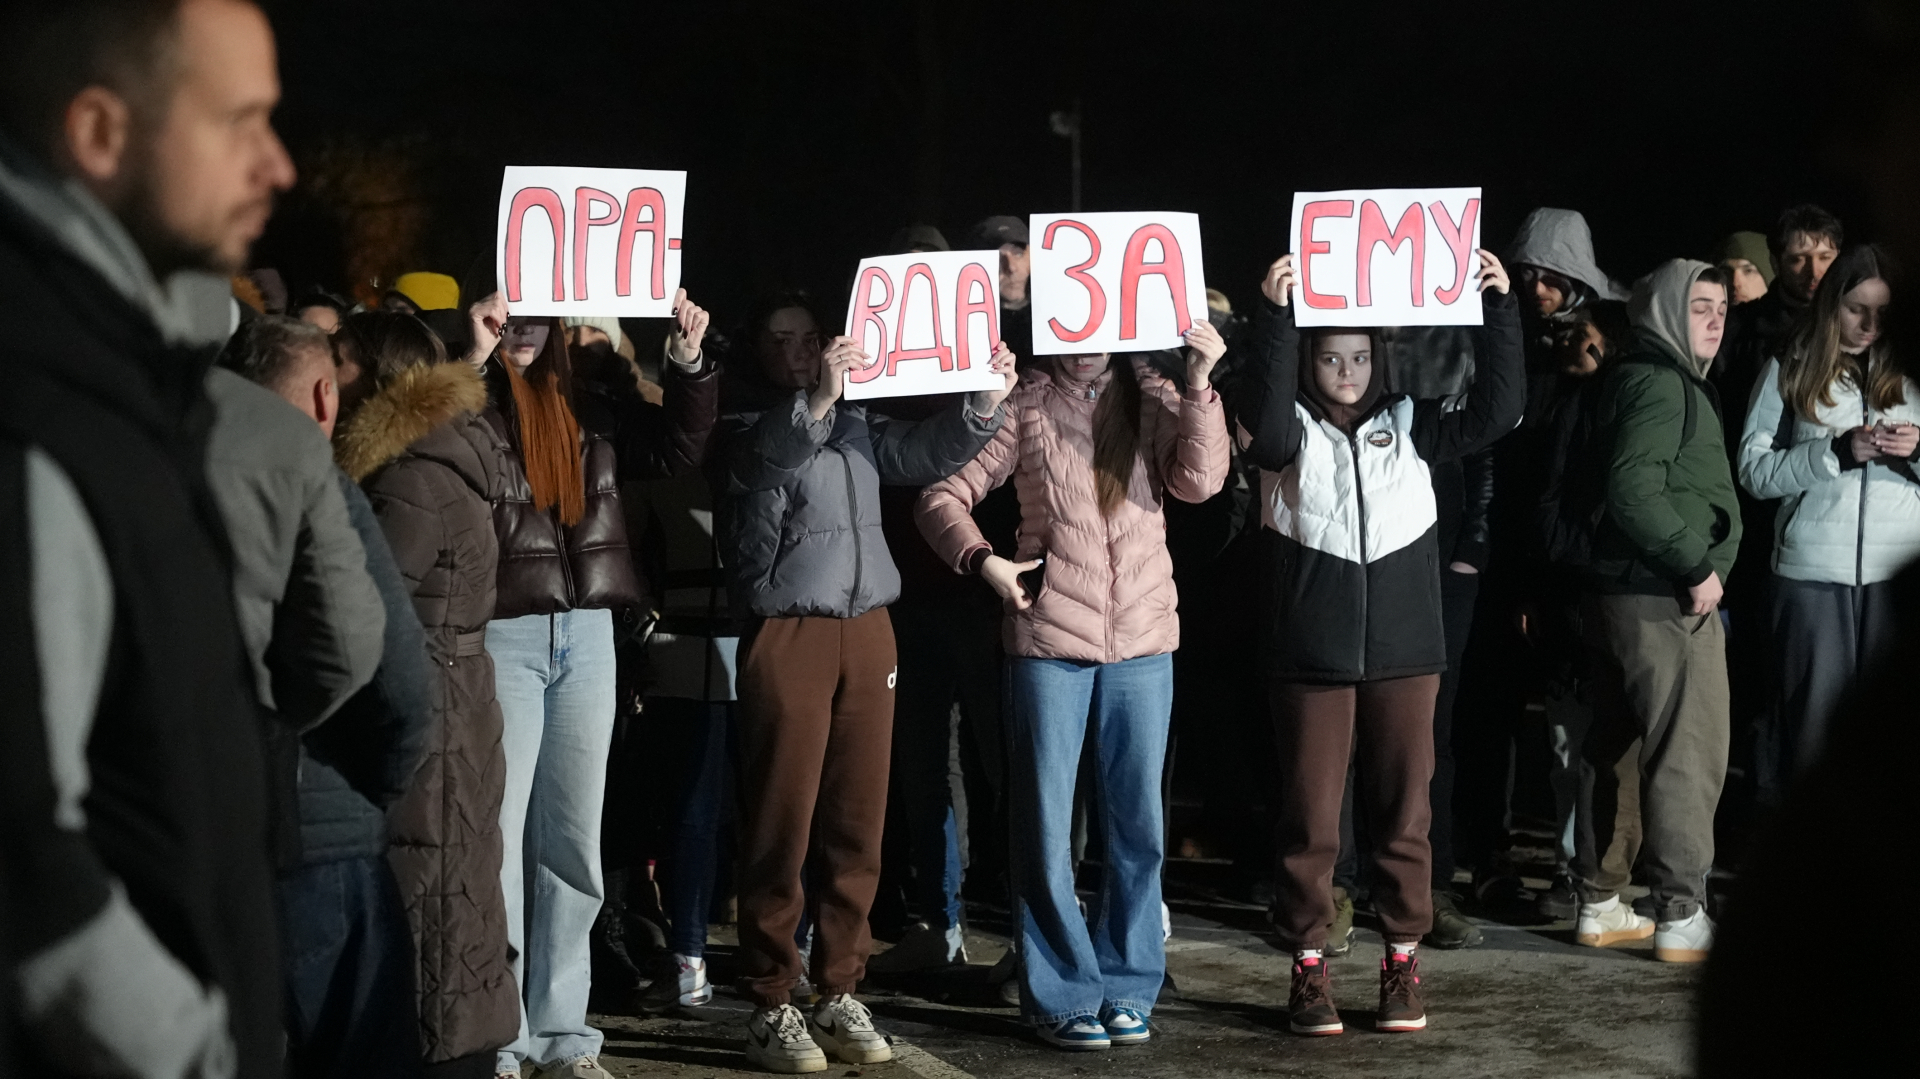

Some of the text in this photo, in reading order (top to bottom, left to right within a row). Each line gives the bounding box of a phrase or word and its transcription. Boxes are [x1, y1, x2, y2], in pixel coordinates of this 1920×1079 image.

[505, 187, 682, 301] ПРА-
[1042, 219, 1191, 342] ЗА
[1300, 198, 1480, 309] ЕМУ
[848, 263, 1000, 383] ВДА
